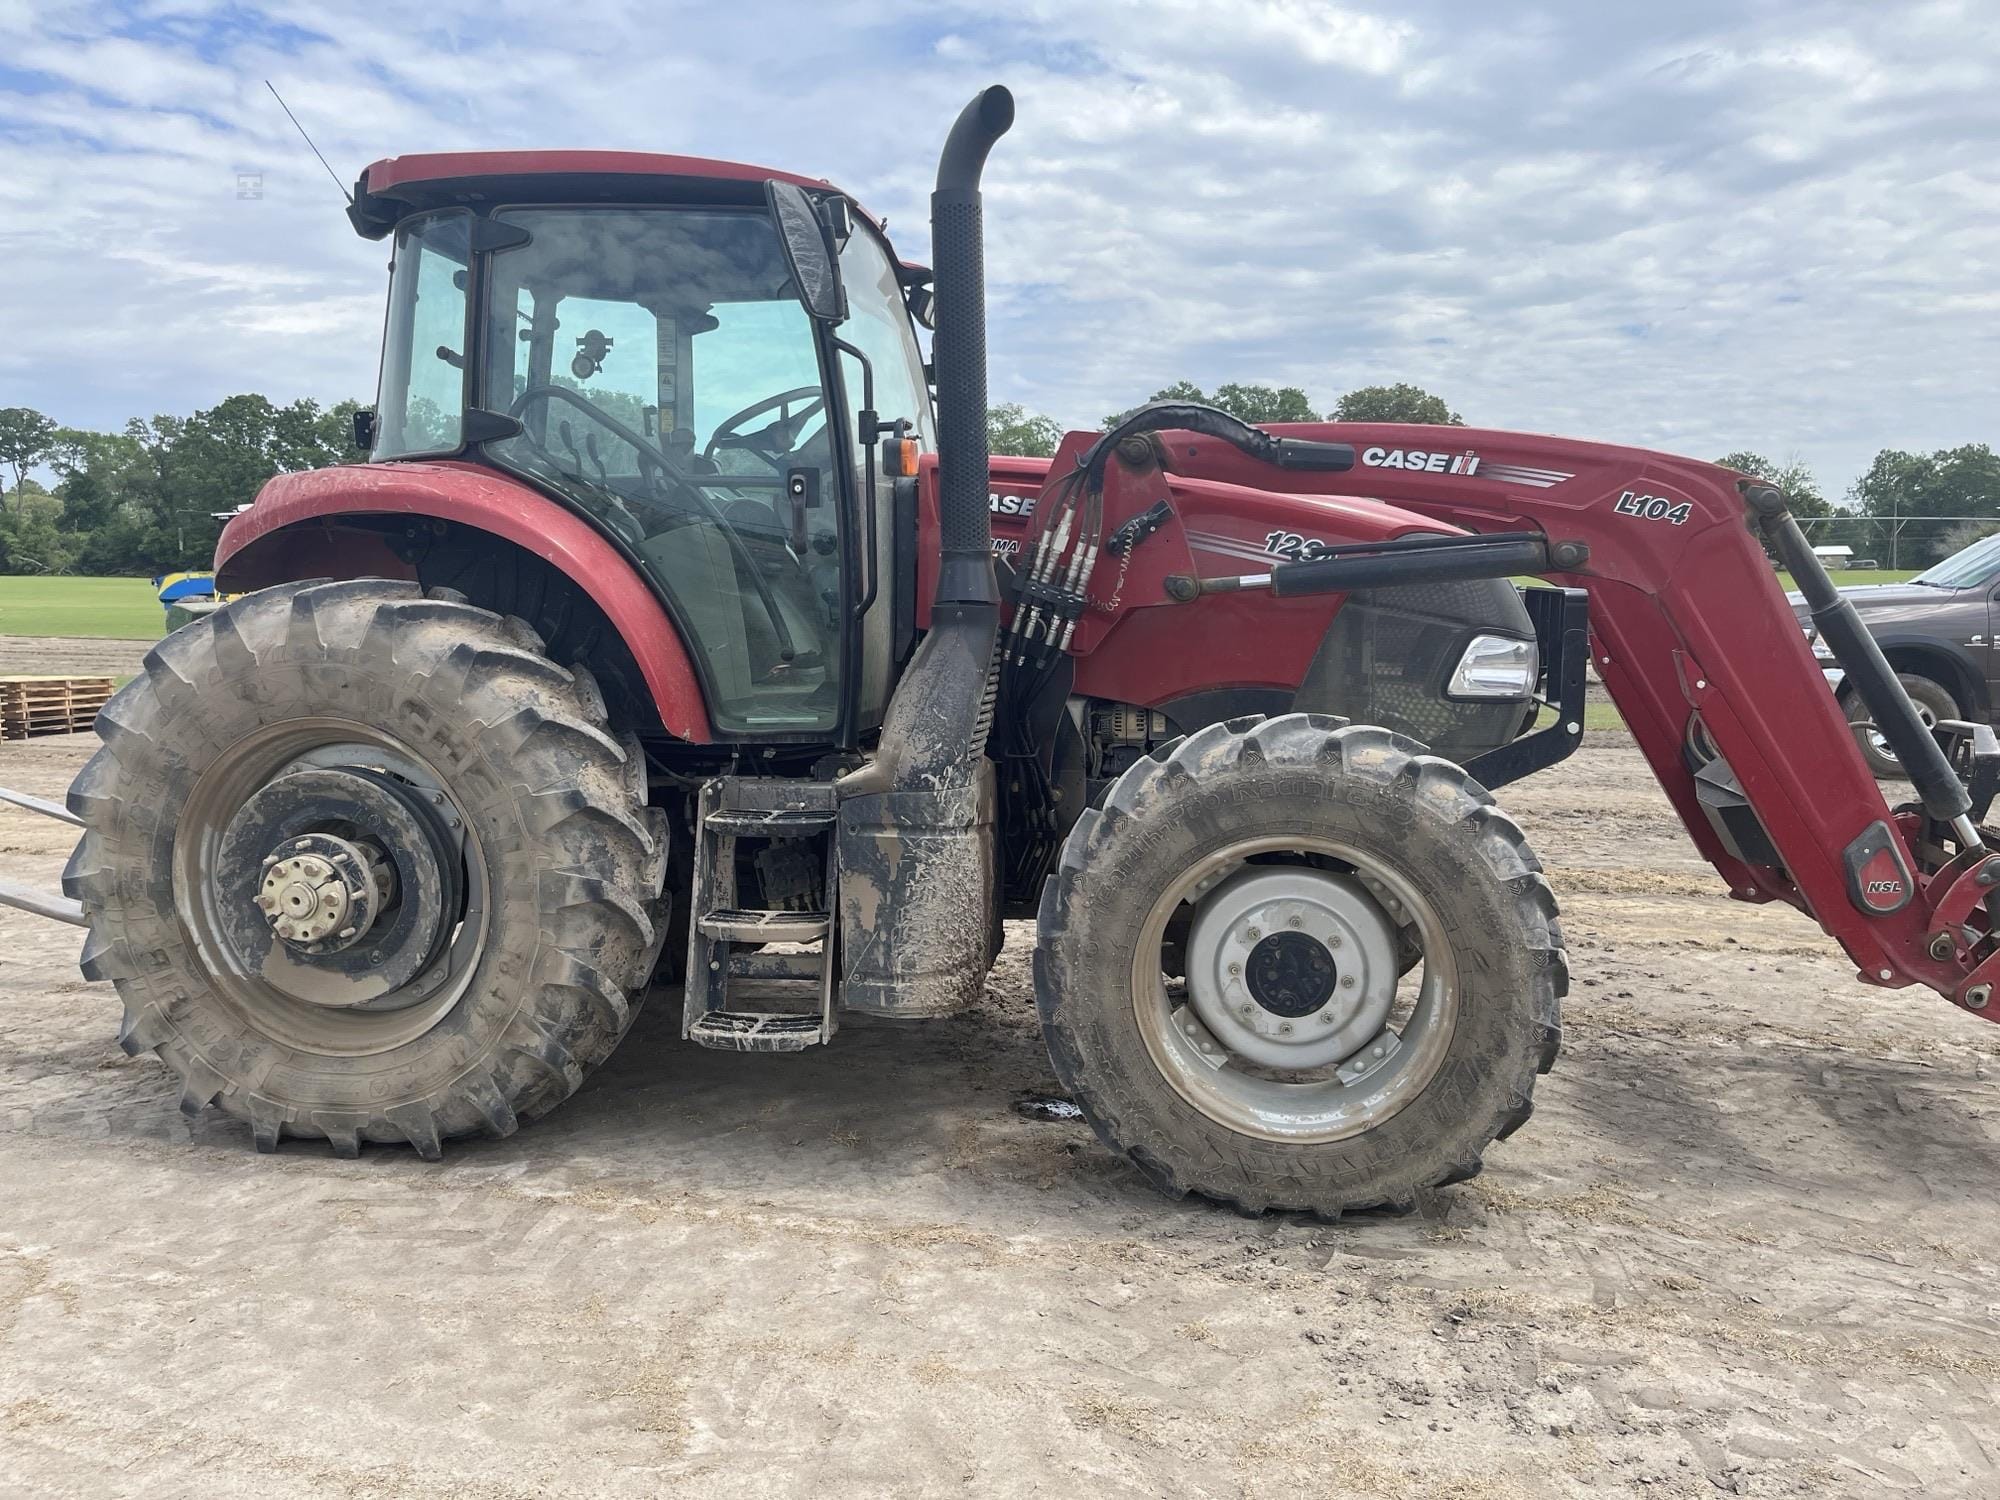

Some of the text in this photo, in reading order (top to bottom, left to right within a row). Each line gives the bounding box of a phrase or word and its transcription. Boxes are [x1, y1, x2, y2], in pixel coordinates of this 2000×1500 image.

[1362, 446, 1449, 473] CASE
[989, 493, 1037, 517] ASE
[1613, 491, 1693, 526] L104
[1231, 778, 1337, 802] Radial
[1867, 881, 1902, 894] NSL
